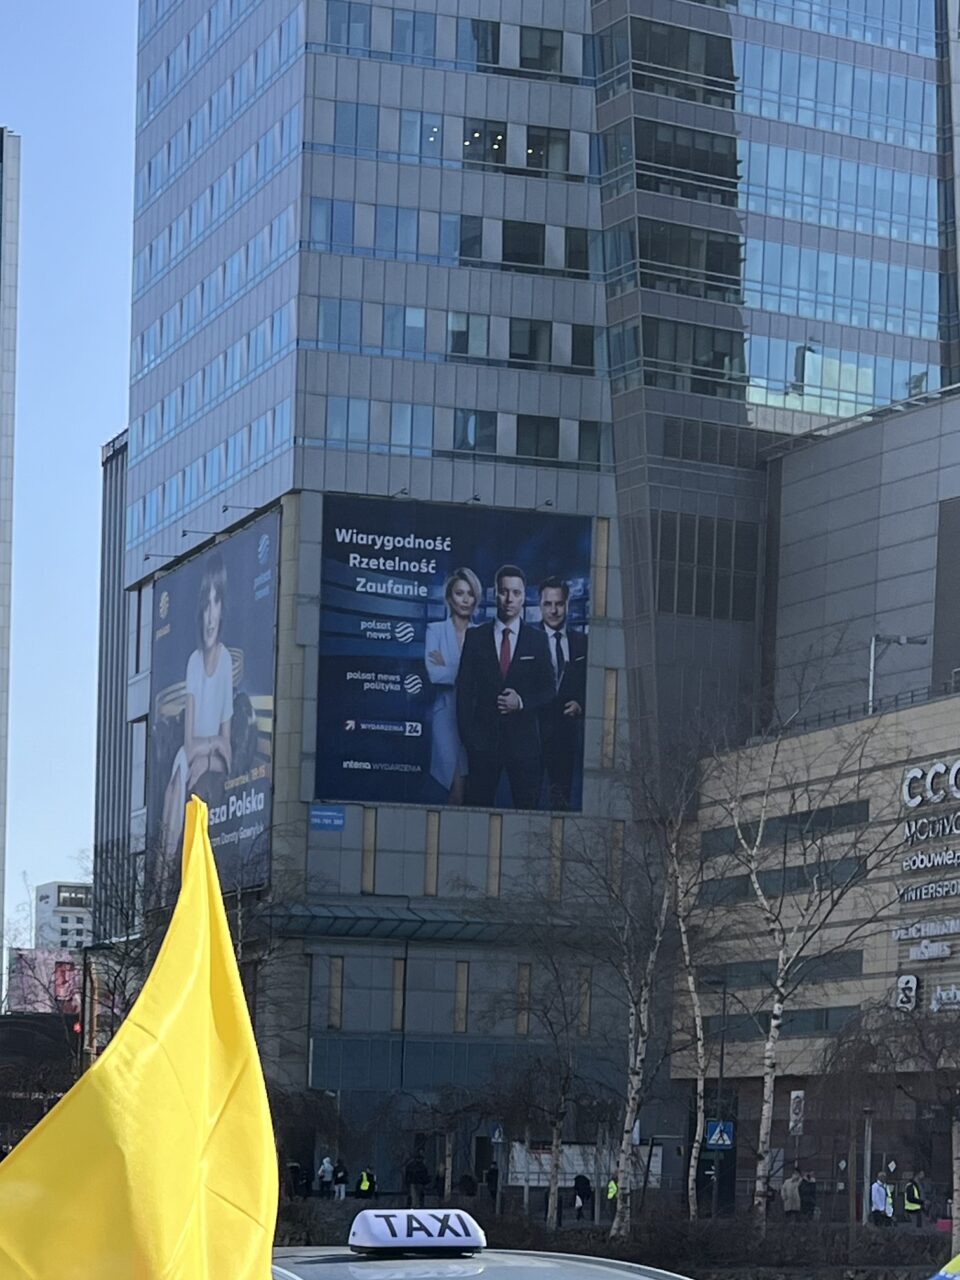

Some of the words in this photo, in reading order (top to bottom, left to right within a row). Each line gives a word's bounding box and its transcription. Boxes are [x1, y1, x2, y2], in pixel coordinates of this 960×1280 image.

[335, 528, 451, 551] Wiarygodność
[349, 553, 436, 573] Rzetelność
[356, 577, 428, 597] Zaufanie
[360, 620, 391, 630] polsat
[366, 631, 391, 640] news
[346, 671, 375, 680] polsat
[377, 673, 400, 681] news
[209, 805, 228, 826] sza
[228, 788, 265, 820] Polska
[374, 1213, 472, 1238] TAXI
